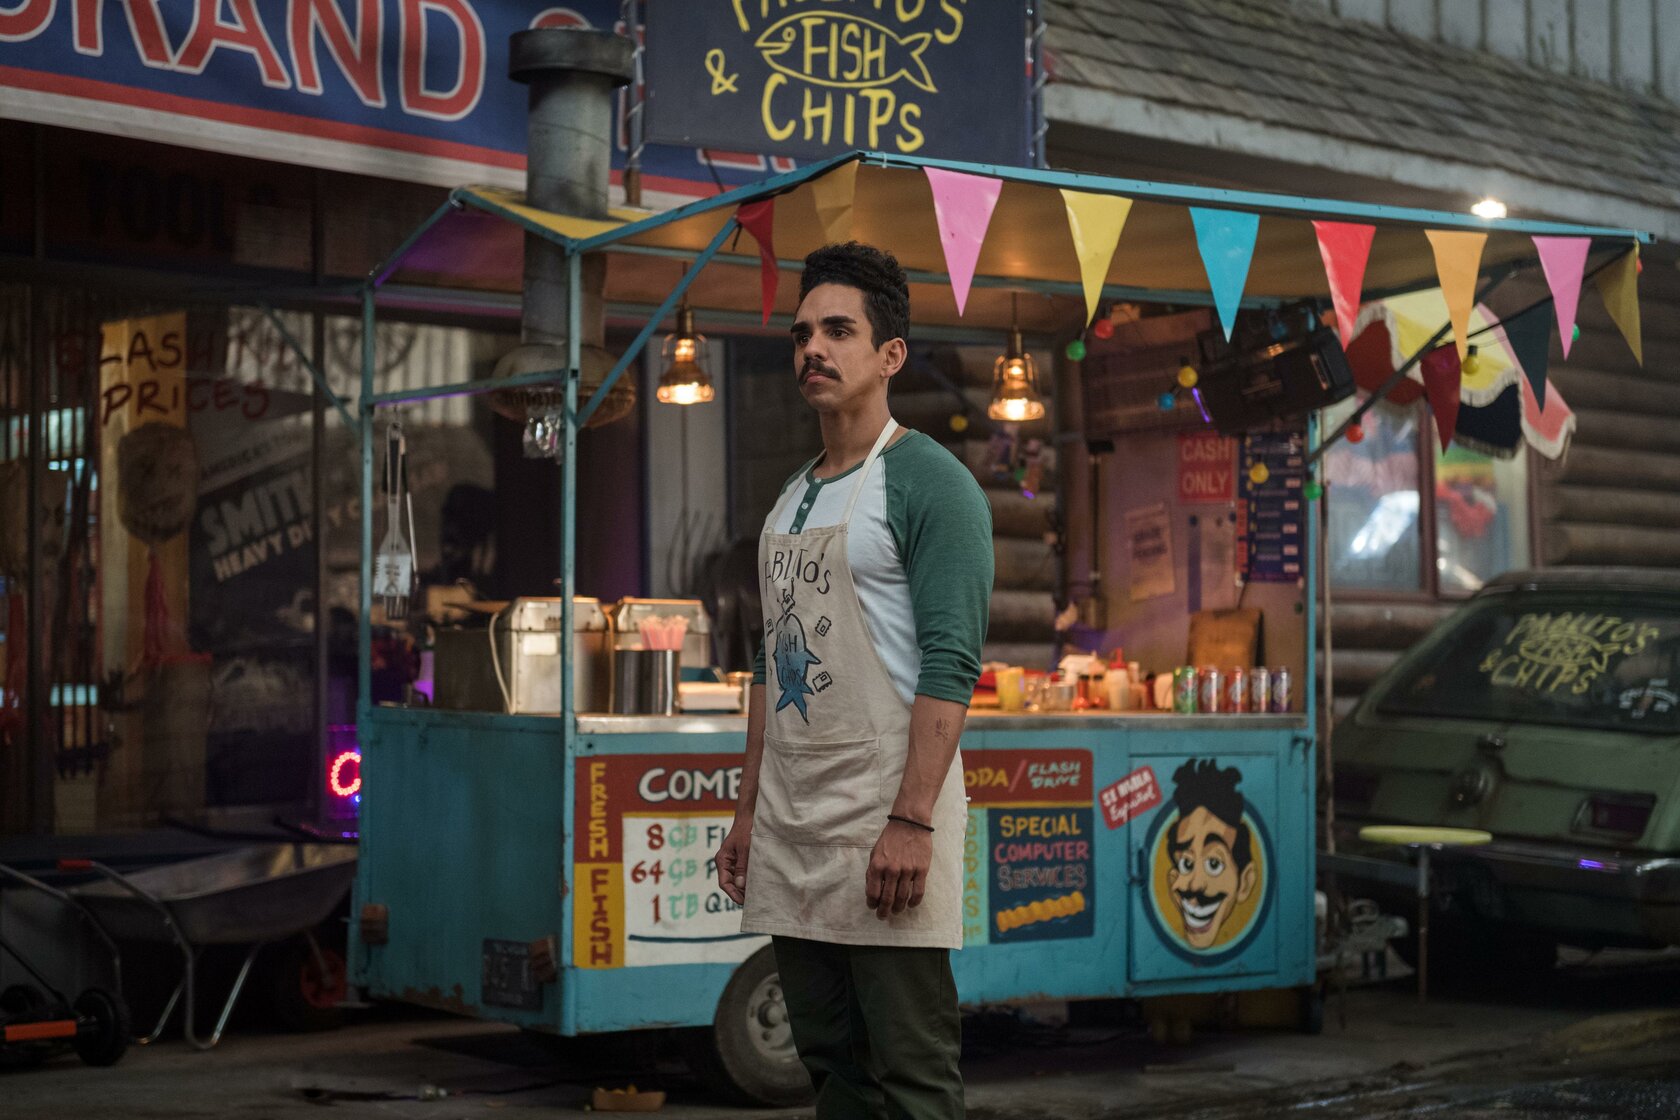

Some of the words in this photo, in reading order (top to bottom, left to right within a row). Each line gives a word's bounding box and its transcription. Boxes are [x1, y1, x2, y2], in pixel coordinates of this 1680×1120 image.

[800, 17, 887, 80] FISH
[704, 48, 739, 95] &
[760, 73, 925, 152] CHIPS
[102, 377, 270, 426] PRICES
[1181, 439, 1231, 462] CASH
[1182, 472, 1231, 494] ONLY
[212, 530, 284, 583] HEAVY
[1490, 654, 1599, 694] CHIPS
[1027, 761, 1081, 779] FLASH
[1030, 773, 1081, 790] DRIVE
[588, 762, 609, 858] FRESH
[646, 823, 665, 851] 8
[668, 824, 698, 849] GB
[1000, 813, 1081, 838] SPECIAL
[994, 839, 1089, 864] COMPUTER
[631, 859, 665, 885] 64
[668, 858, 698, 887] GB
[999, 865, 1087, 889] SERVICES
[589, 868, 612, 966] FISH
[650, 895, 662, 925] 1
[667, 894, 699, 921] TB
